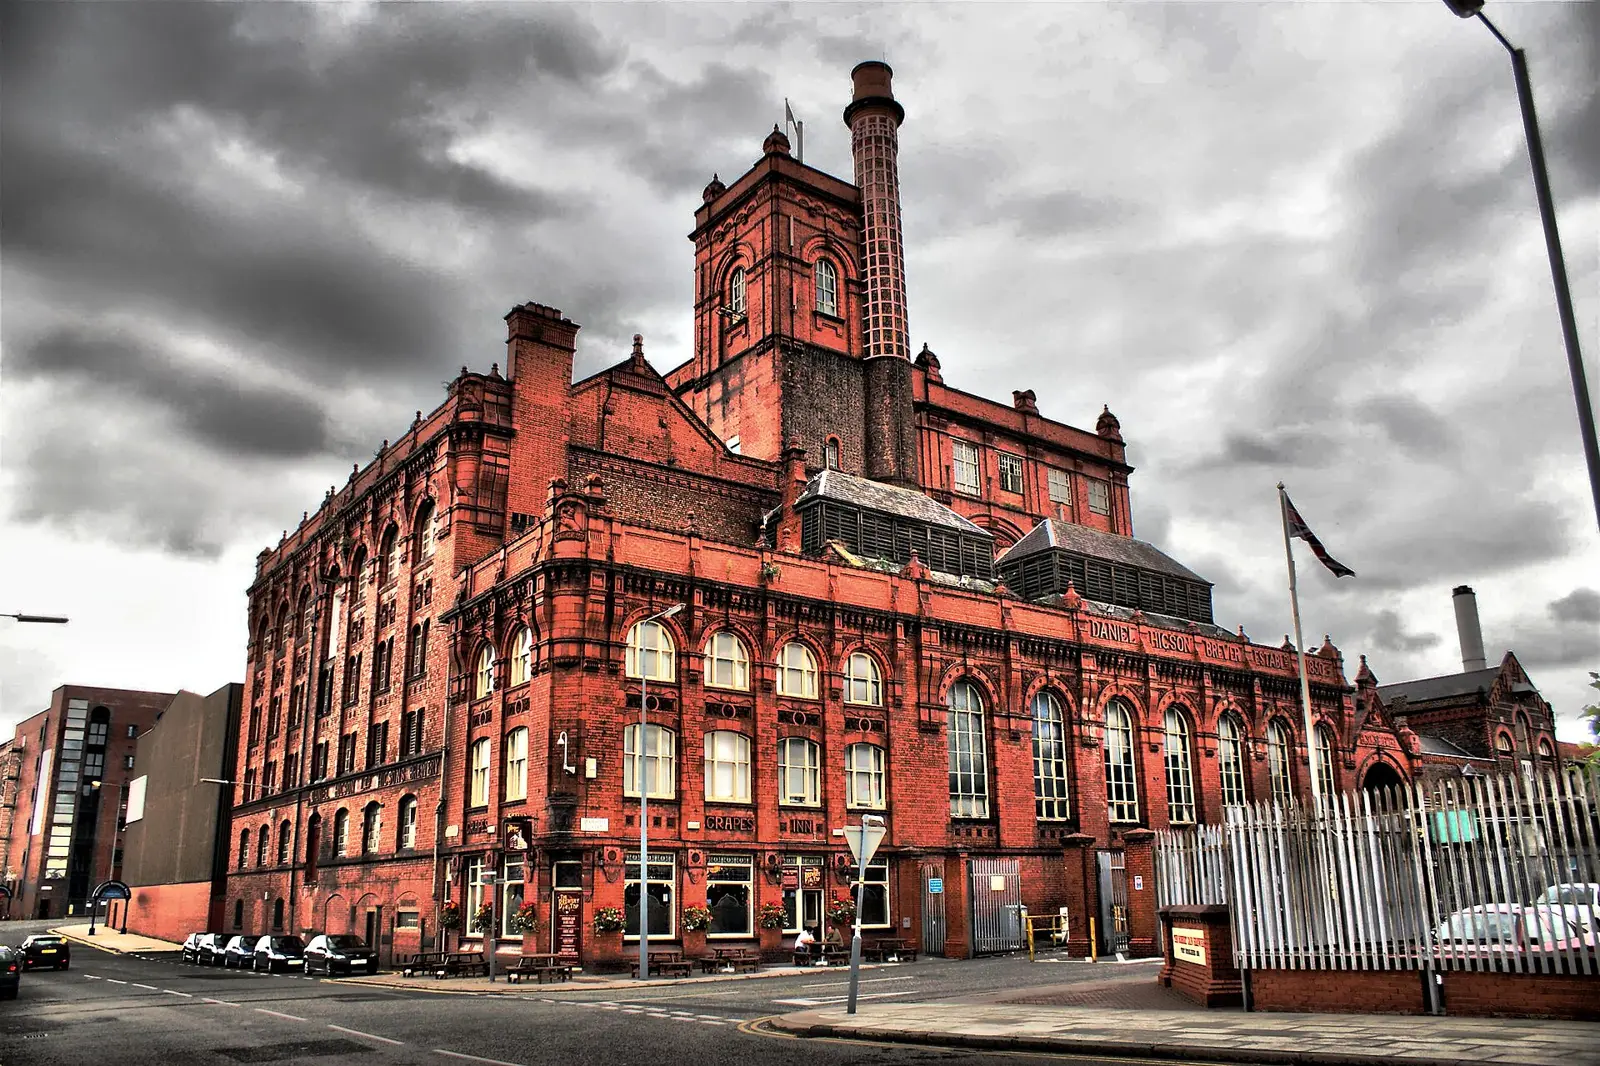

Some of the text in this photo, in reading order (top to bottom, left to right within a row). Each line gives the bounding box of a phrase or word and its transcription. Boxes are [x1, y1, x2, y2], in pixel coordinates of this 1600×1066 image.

[1090, 619, 1136, 644] DANIEL
[1149, 630, 1192, 654] HIGSON
[1204, 640, 1242, 663] BREWER
[706, 816, 755, 832] GRAPES
[792, 820, 813, 834] INN
